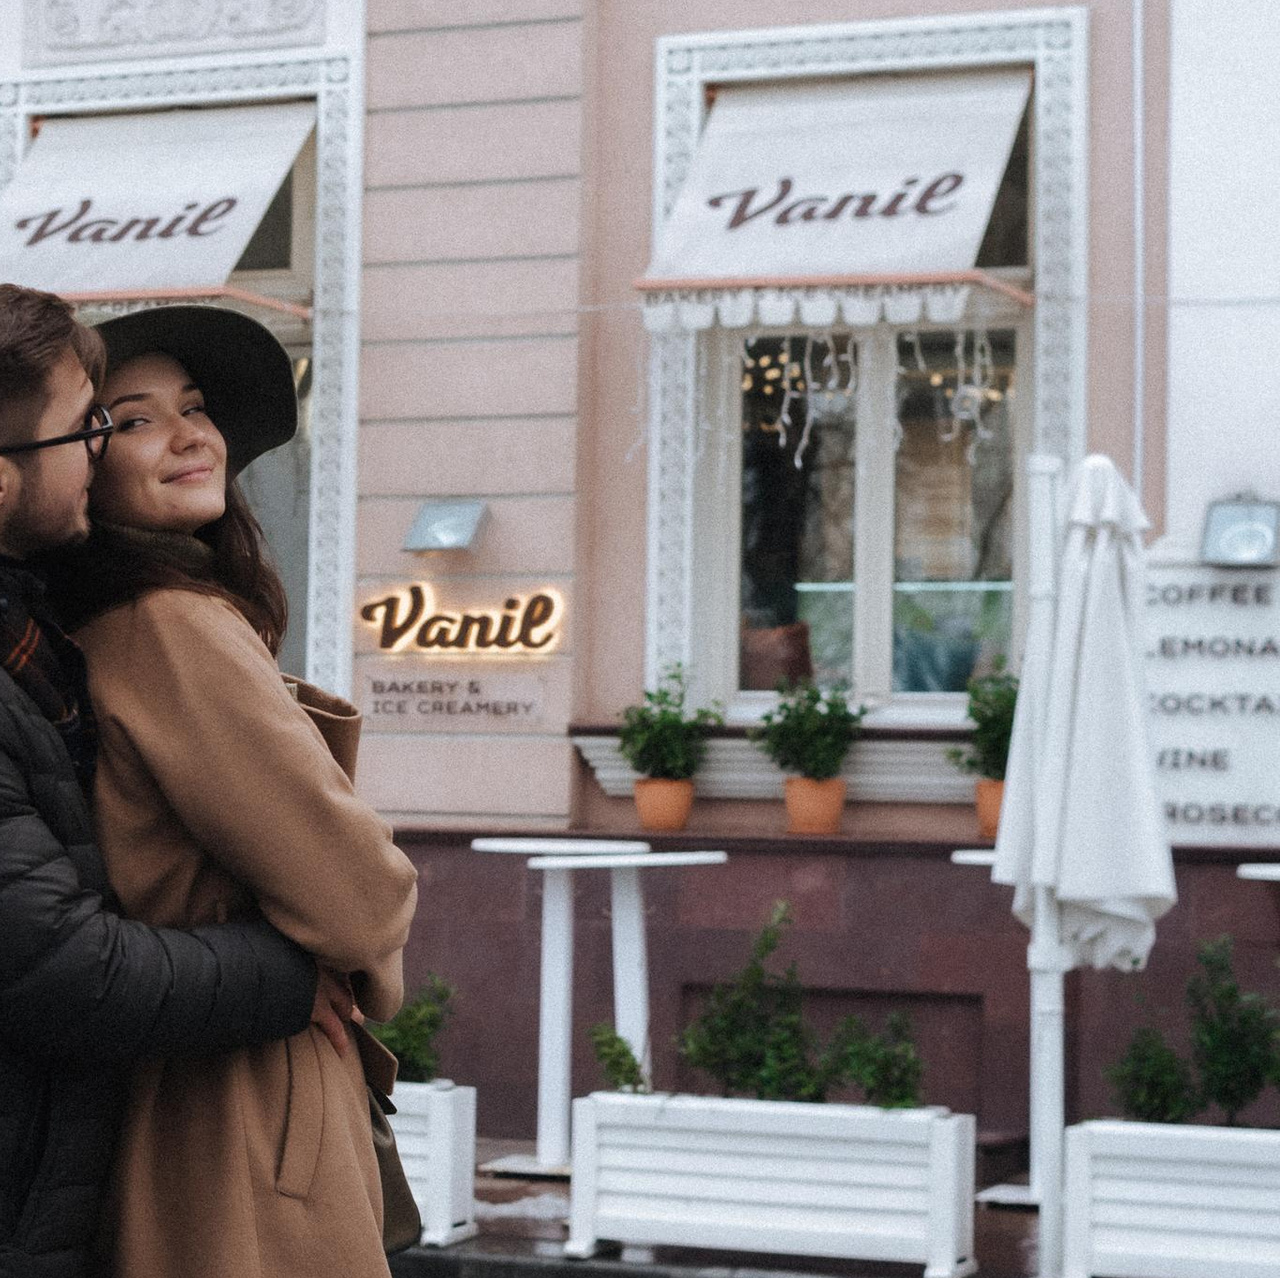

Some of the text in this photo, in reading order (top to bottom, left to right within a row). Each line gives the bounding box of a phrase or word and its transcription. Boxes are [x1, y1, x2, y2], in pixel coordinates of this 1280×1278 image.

[707, 172, 965, 230] Vanil
[16, 197, 237, 247] Vanil
[361, 585, 555, 649] Vanil
[1146, 636, 1280, 660] EMONA
[372, 681, 458, 694] BAKERY
[372, 701, 533, 715] ICE CREAMERY
[1148, 692, 1280, 716] OCKTA
